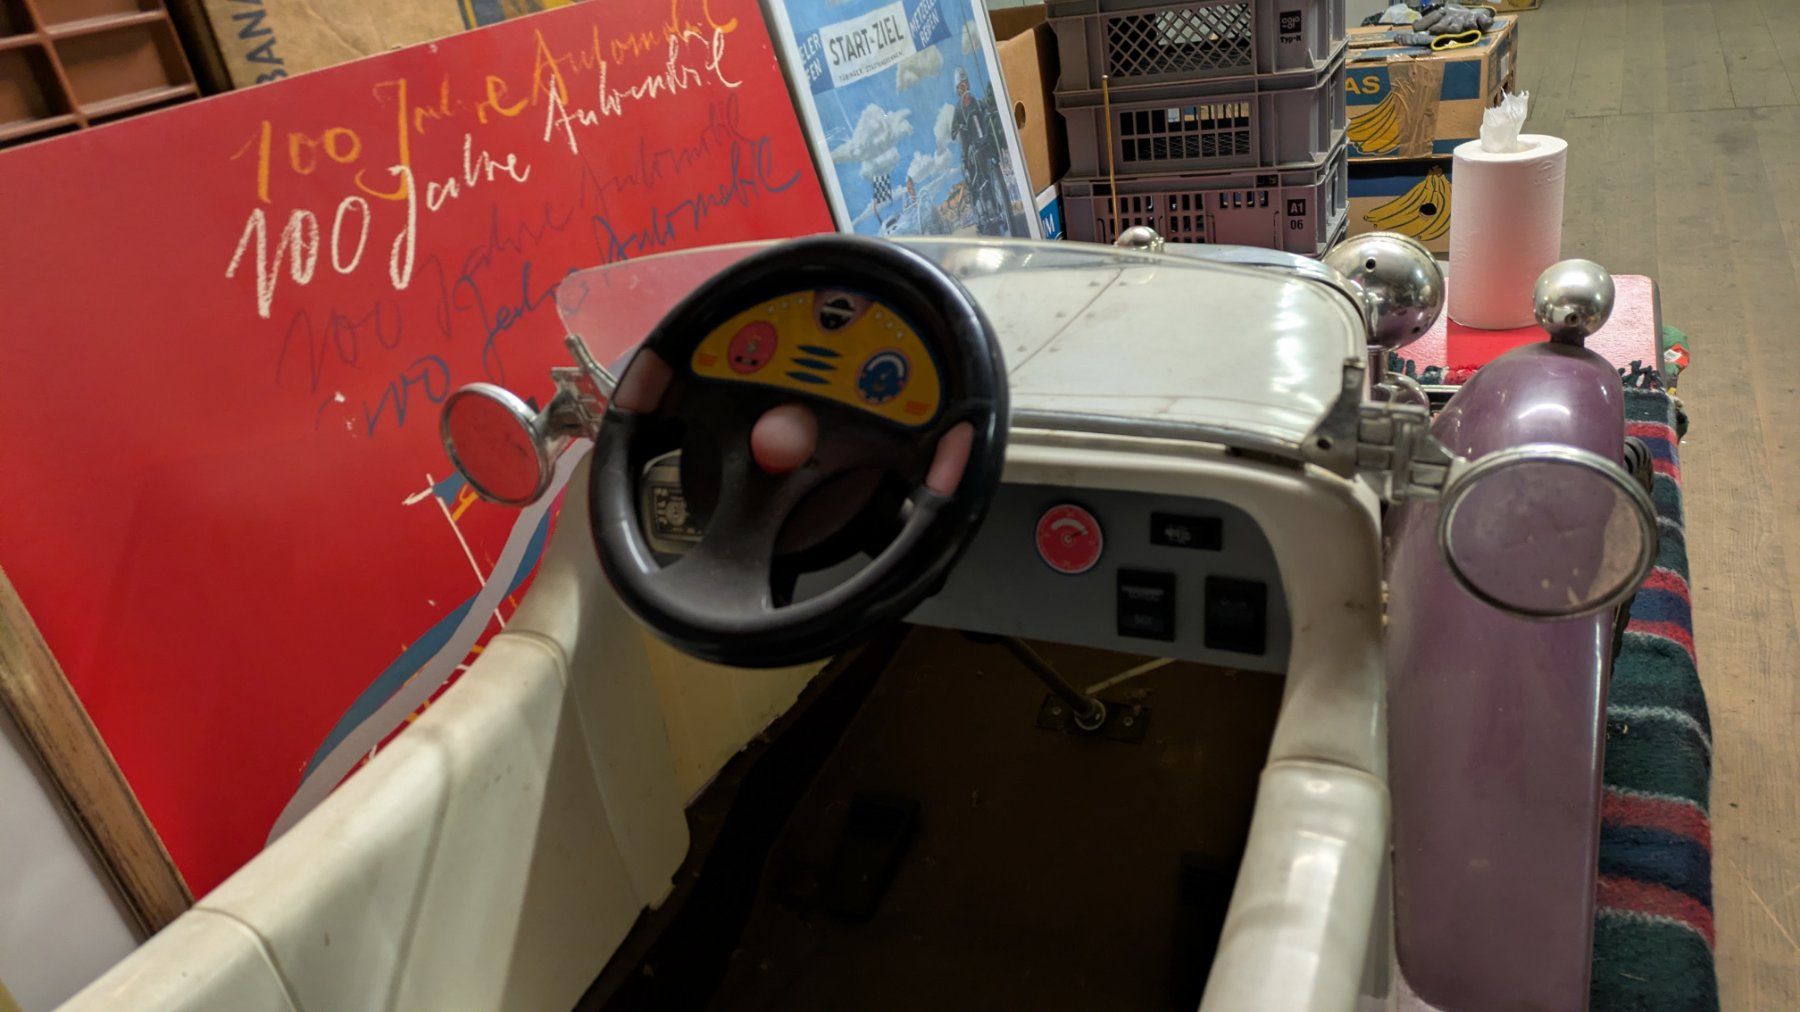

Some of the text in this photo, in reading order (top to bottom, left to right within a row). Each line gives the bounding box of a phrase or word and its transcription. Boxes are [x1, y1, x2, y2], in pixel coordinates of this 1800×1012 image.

[228, 0, 288, 85] BAN
[230, 120, 362, 203] 100
[225, 196, 371, 318] 100
[1290, 219, 1304, 230] 06
